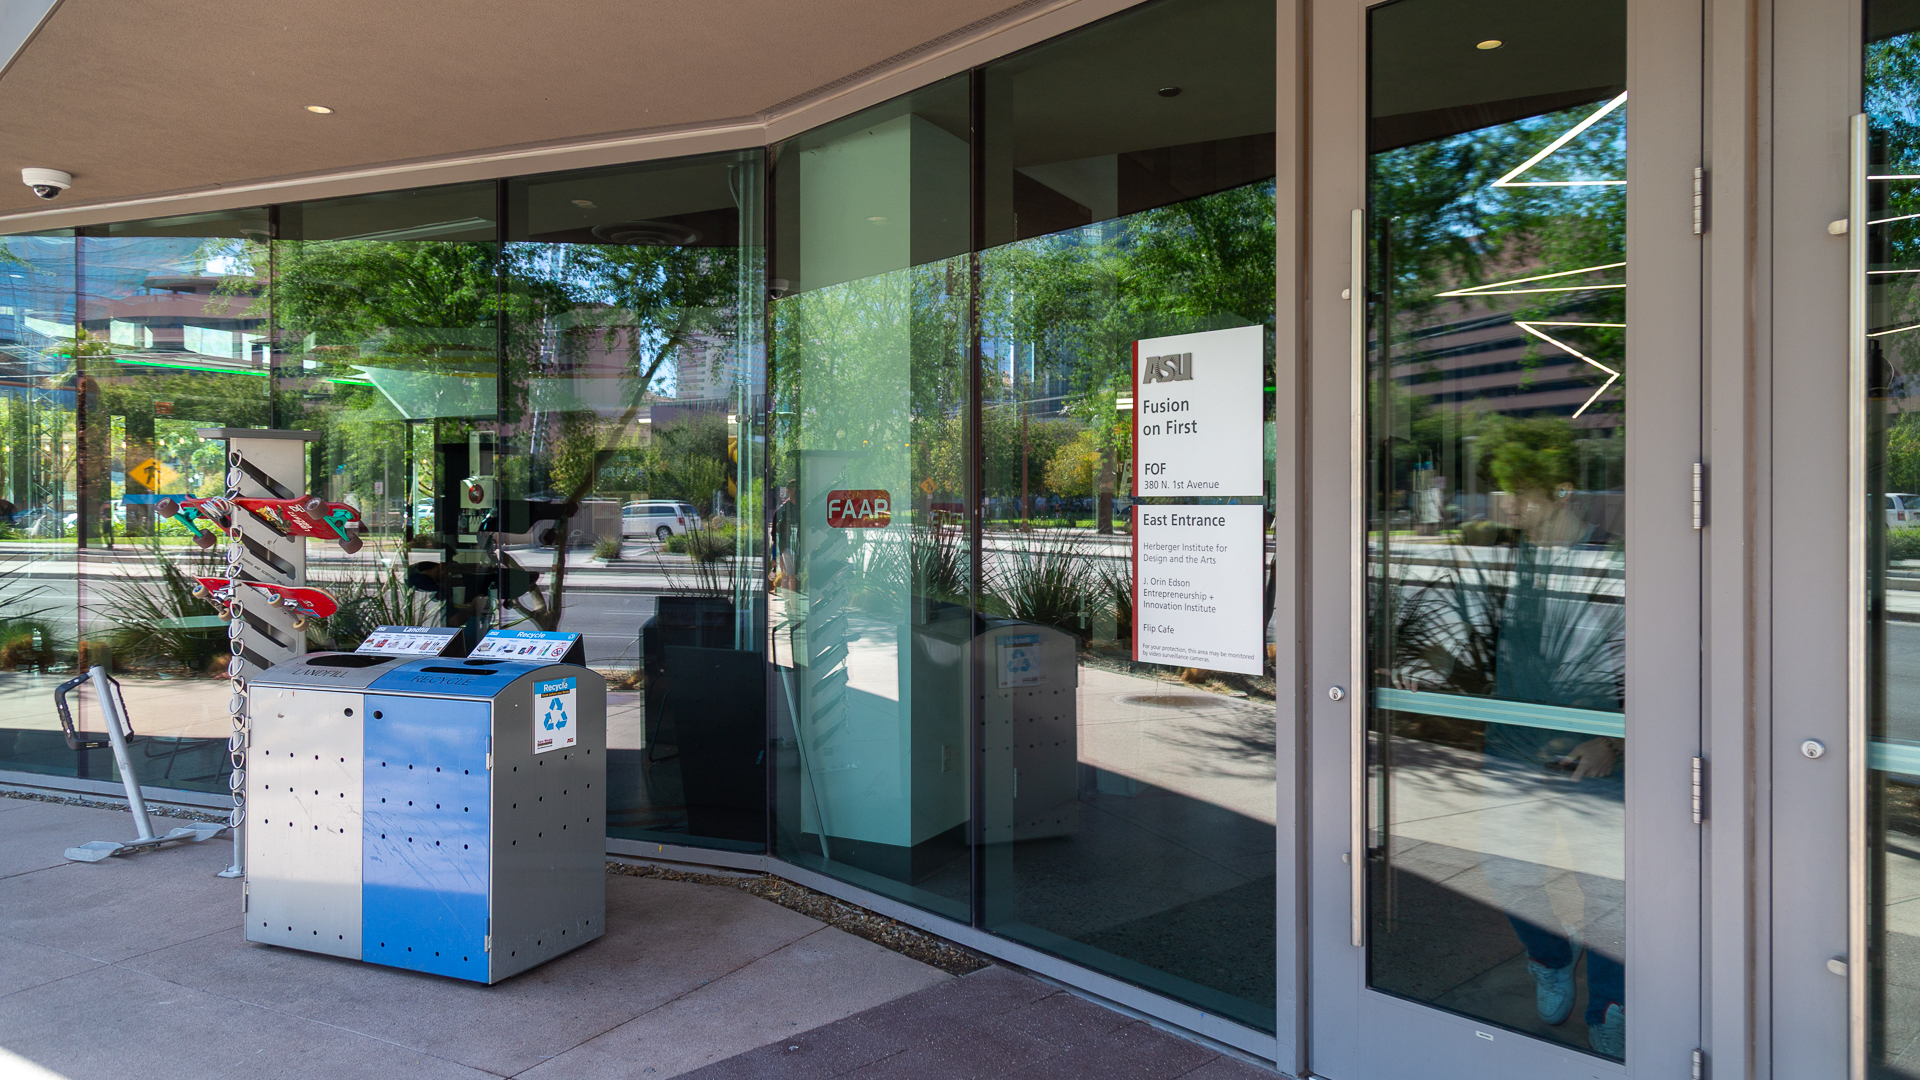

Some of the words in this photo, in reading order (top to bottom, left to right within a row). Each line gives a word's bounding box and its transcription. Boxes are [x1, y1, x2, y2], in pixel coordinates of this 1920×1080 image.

[1143, 352, 1193, 384] ASU
[1143, 398, 1189, 414] Fusion
[1143, 424, 1160, 435] on
[1166, 420, 1197, 435] First
[1144, 463, 1166, 475] FOF
[1144, 481, 1159, 489] 380
[1161, 481, 1170, 489] N.
[1173, 480, 1184, 489] 1st
[1187, 480, 1219, 489] Avenue
[828, 498, 888, 519] FAAP
[1143, 513, 1167, 526] East
[1171, 514, 1226, 527] Entrance
[1143, 542, 1180, 552] Herberger
[1182, 543, 1214, 552] Institute
[1216, 543, 1228, 552] for
[1143, 554, 1168, 565] Design
[1169, 554, 1184, 563] and
[1185, 554, 1199, 564] the
[1200, 555, 1217, 564] Arts
[1150, 578, 1167, 586] Orin
[1168, 578, 1191, 587] Edson
[1143, 589, 1208, 601] Entrepreneurship
[1143, 601, 1183, 611] Innovation
[1184, 603, 1217, 613] Institute
[1143, 624, 1156, 634] Flip
[1157, 624, 1175, 634] Cafe
[516, 631, 547, 639] Recycle
[292, 668, 350, 679] LANDFILL
[410, 675, 475, 686] RECYCLE
[544, 683, 568, 692] Recycle
